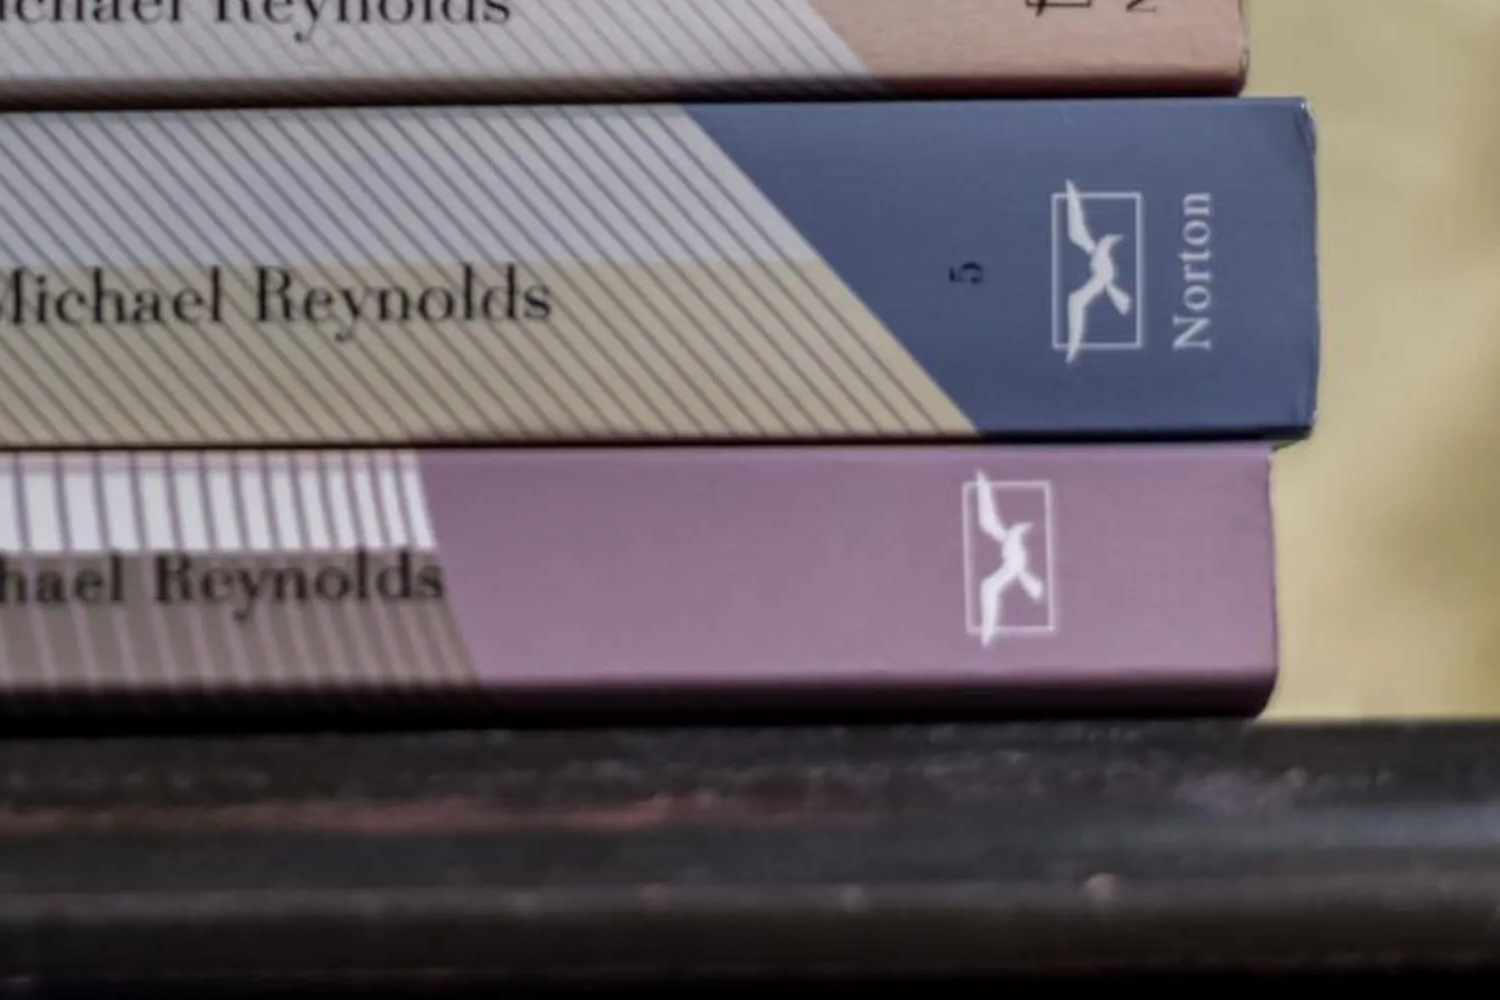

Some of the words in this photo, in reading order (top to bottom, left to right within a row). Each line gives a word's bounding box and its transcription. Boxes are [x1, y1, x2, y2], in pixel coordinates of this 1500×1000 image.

[255, 264, 553, 341] Reynolds
[948, 261, 984, 287] 5
[1172, 191, 1212, 352] Norton
[153, 550, 445, 621] Reynolds
